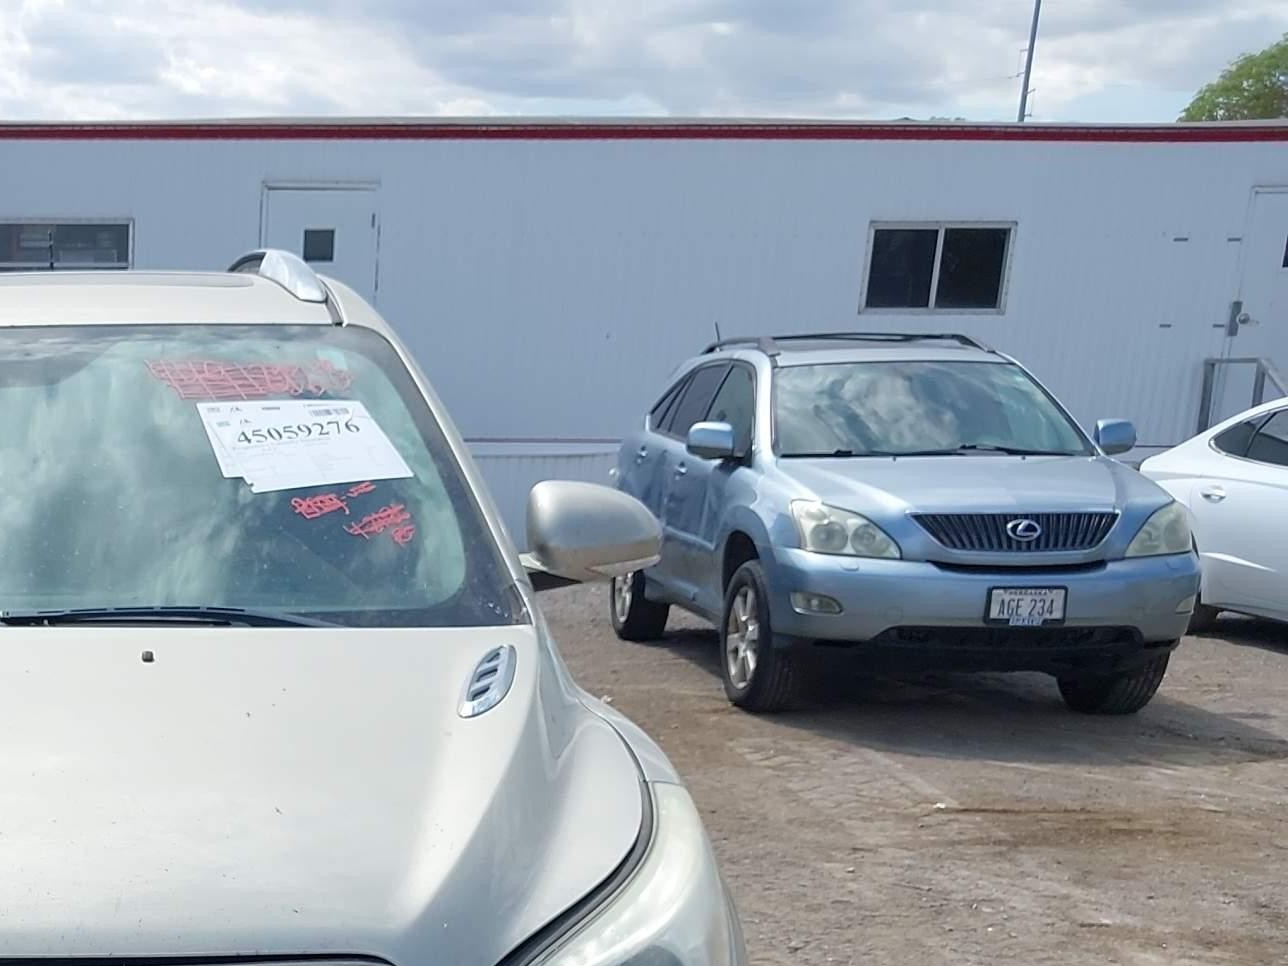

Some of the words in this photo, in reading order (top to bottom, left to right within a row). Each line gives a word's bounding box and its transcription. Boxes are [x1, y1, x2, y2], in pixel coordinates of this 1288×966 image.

[237, 416, 361, 445] 45059276
[998, 598, 1024, 616] AGE
[1028, 598, 1054, 616] 234
